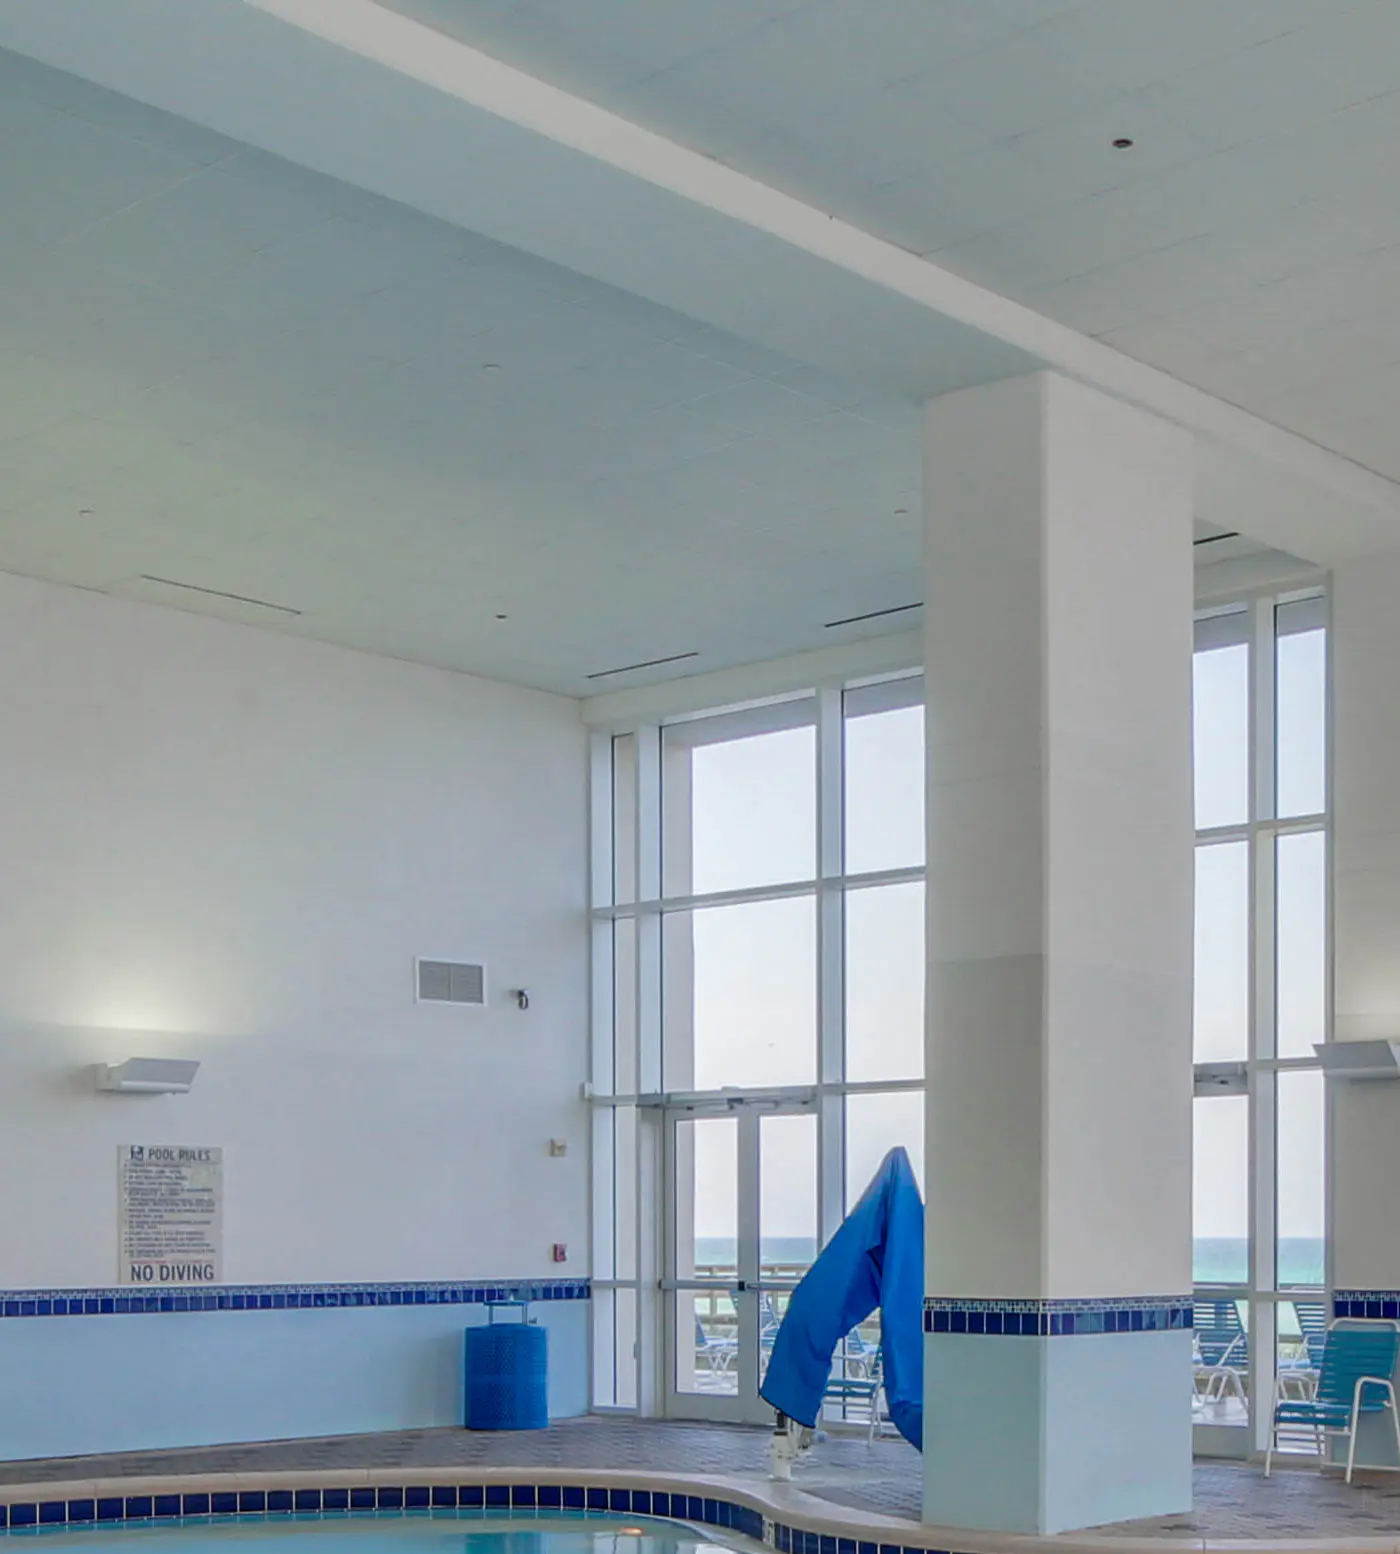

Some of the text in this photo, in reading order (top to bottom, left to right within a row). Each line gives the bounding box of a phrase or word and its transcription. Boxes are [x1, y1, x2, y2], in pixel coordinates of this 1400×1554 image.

[148, 1148, 211, 1161] POOL RULES
[131, 1264, 215, 1282] NO DIVING
